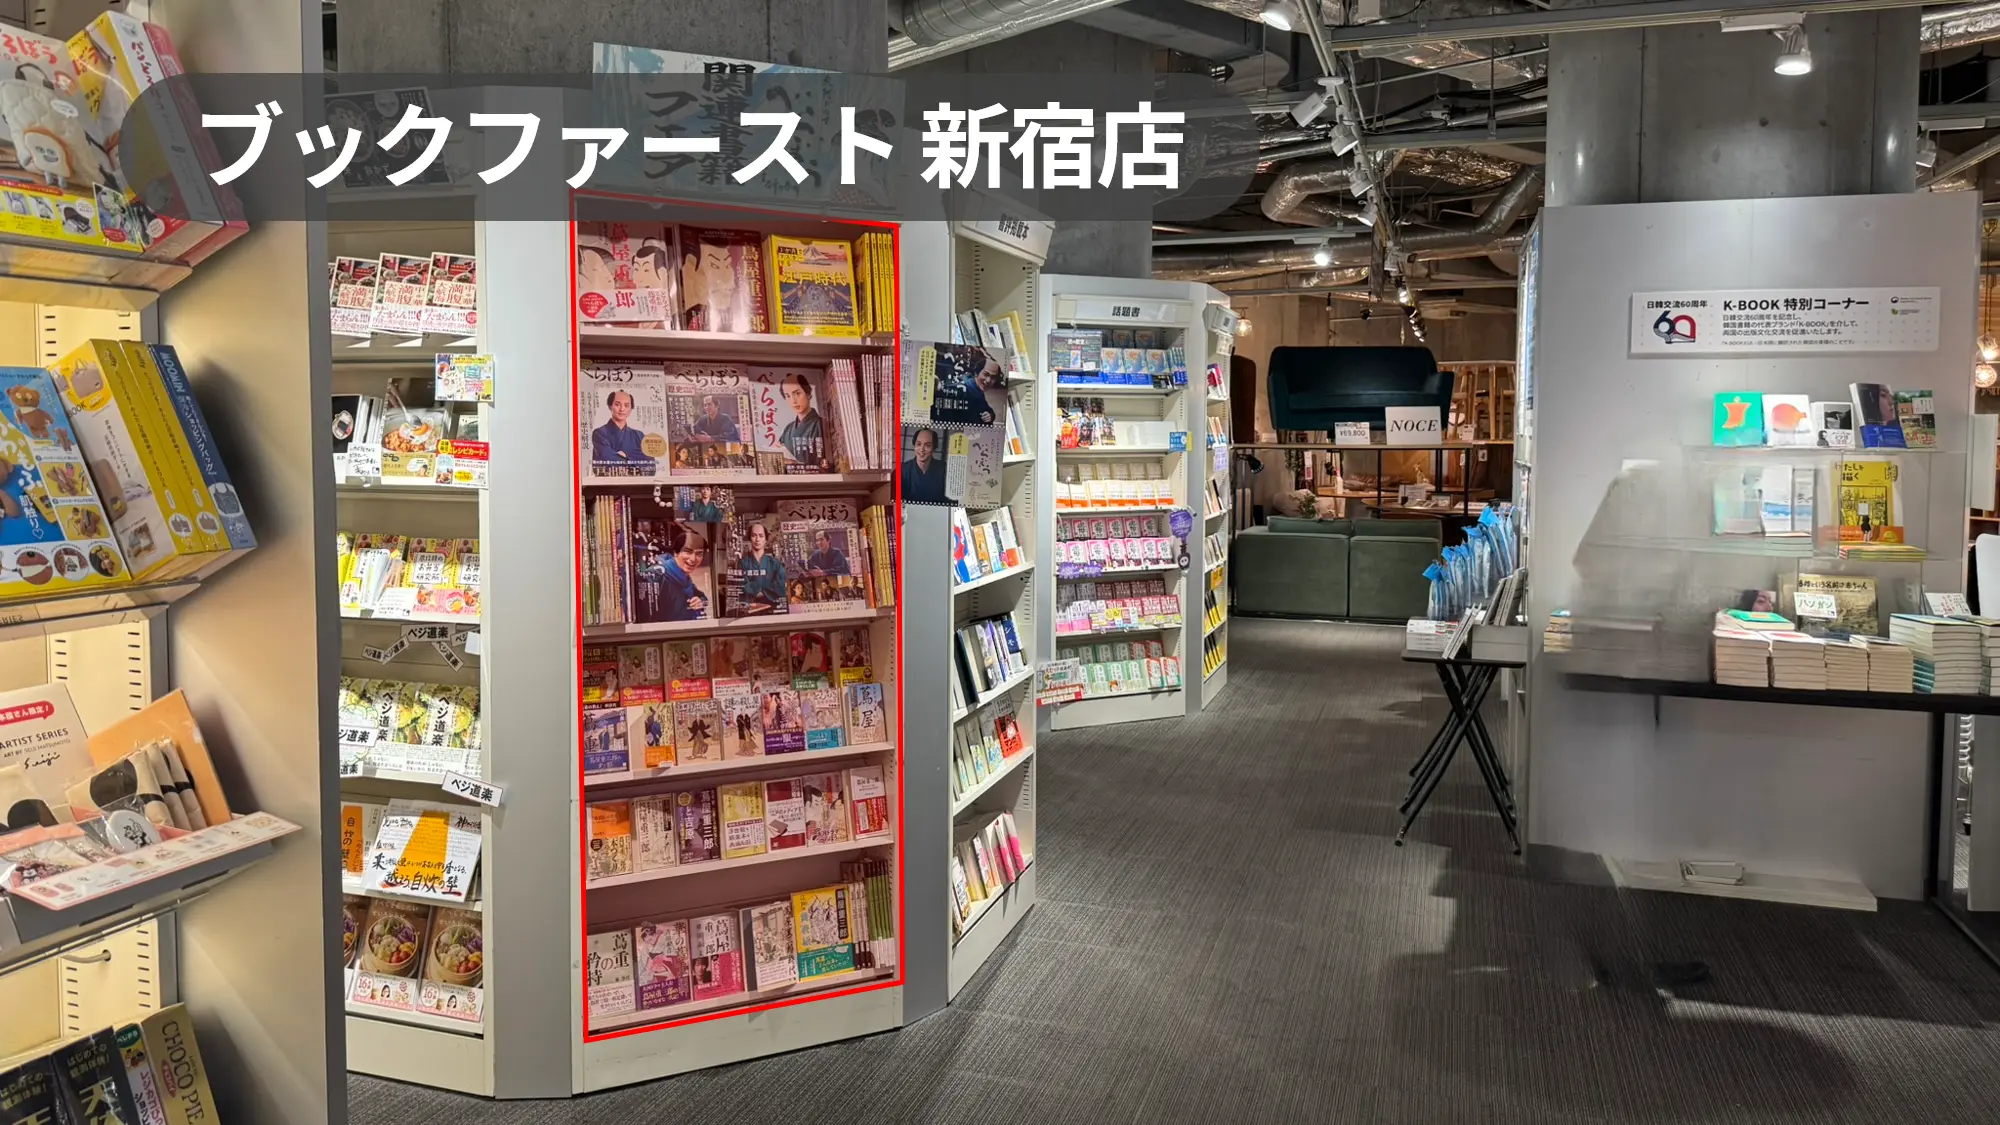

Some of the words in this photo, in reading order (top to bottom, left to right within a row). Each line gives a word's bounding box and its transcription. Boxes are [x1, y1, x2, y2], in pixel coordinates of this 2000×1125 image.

[783, 271, 848, 287] 江戸時代
[1112, 306, 1141, 317] 話題書
[1647, 300, 1708, 309] 日韓交流60周年
[1723, 300, 1780, 311] K-BOOK
[1784, 298, 1869, 311] 特別コーナー
[160, 351, 186, 393] MOOMIN
[580, 366, 634, 383] べらぼう
[675, 369, 740, 388] べらぼう
[757, 371, 779, 447] べらぼう
[1390, 419, 1438, 433] NOCE
[788, 504, 850, 522] べらぼう
[408, 626, 448, 639] ベジ道楽
[376, 692, 394, 741] ベジ道楽
[431, 697, 450, 746] ベジ道楽
[0, 736, 33, 750] ARTIST
[36, 727, 69, 742] SERIES
[451, 778, 494, 803] ベジ道楽
[700, 790, 714, 850] 蔦屋重三郎
[161, 1021, 194, 1089] CHOCO
[181, 1089, 205, 1125] PIE
